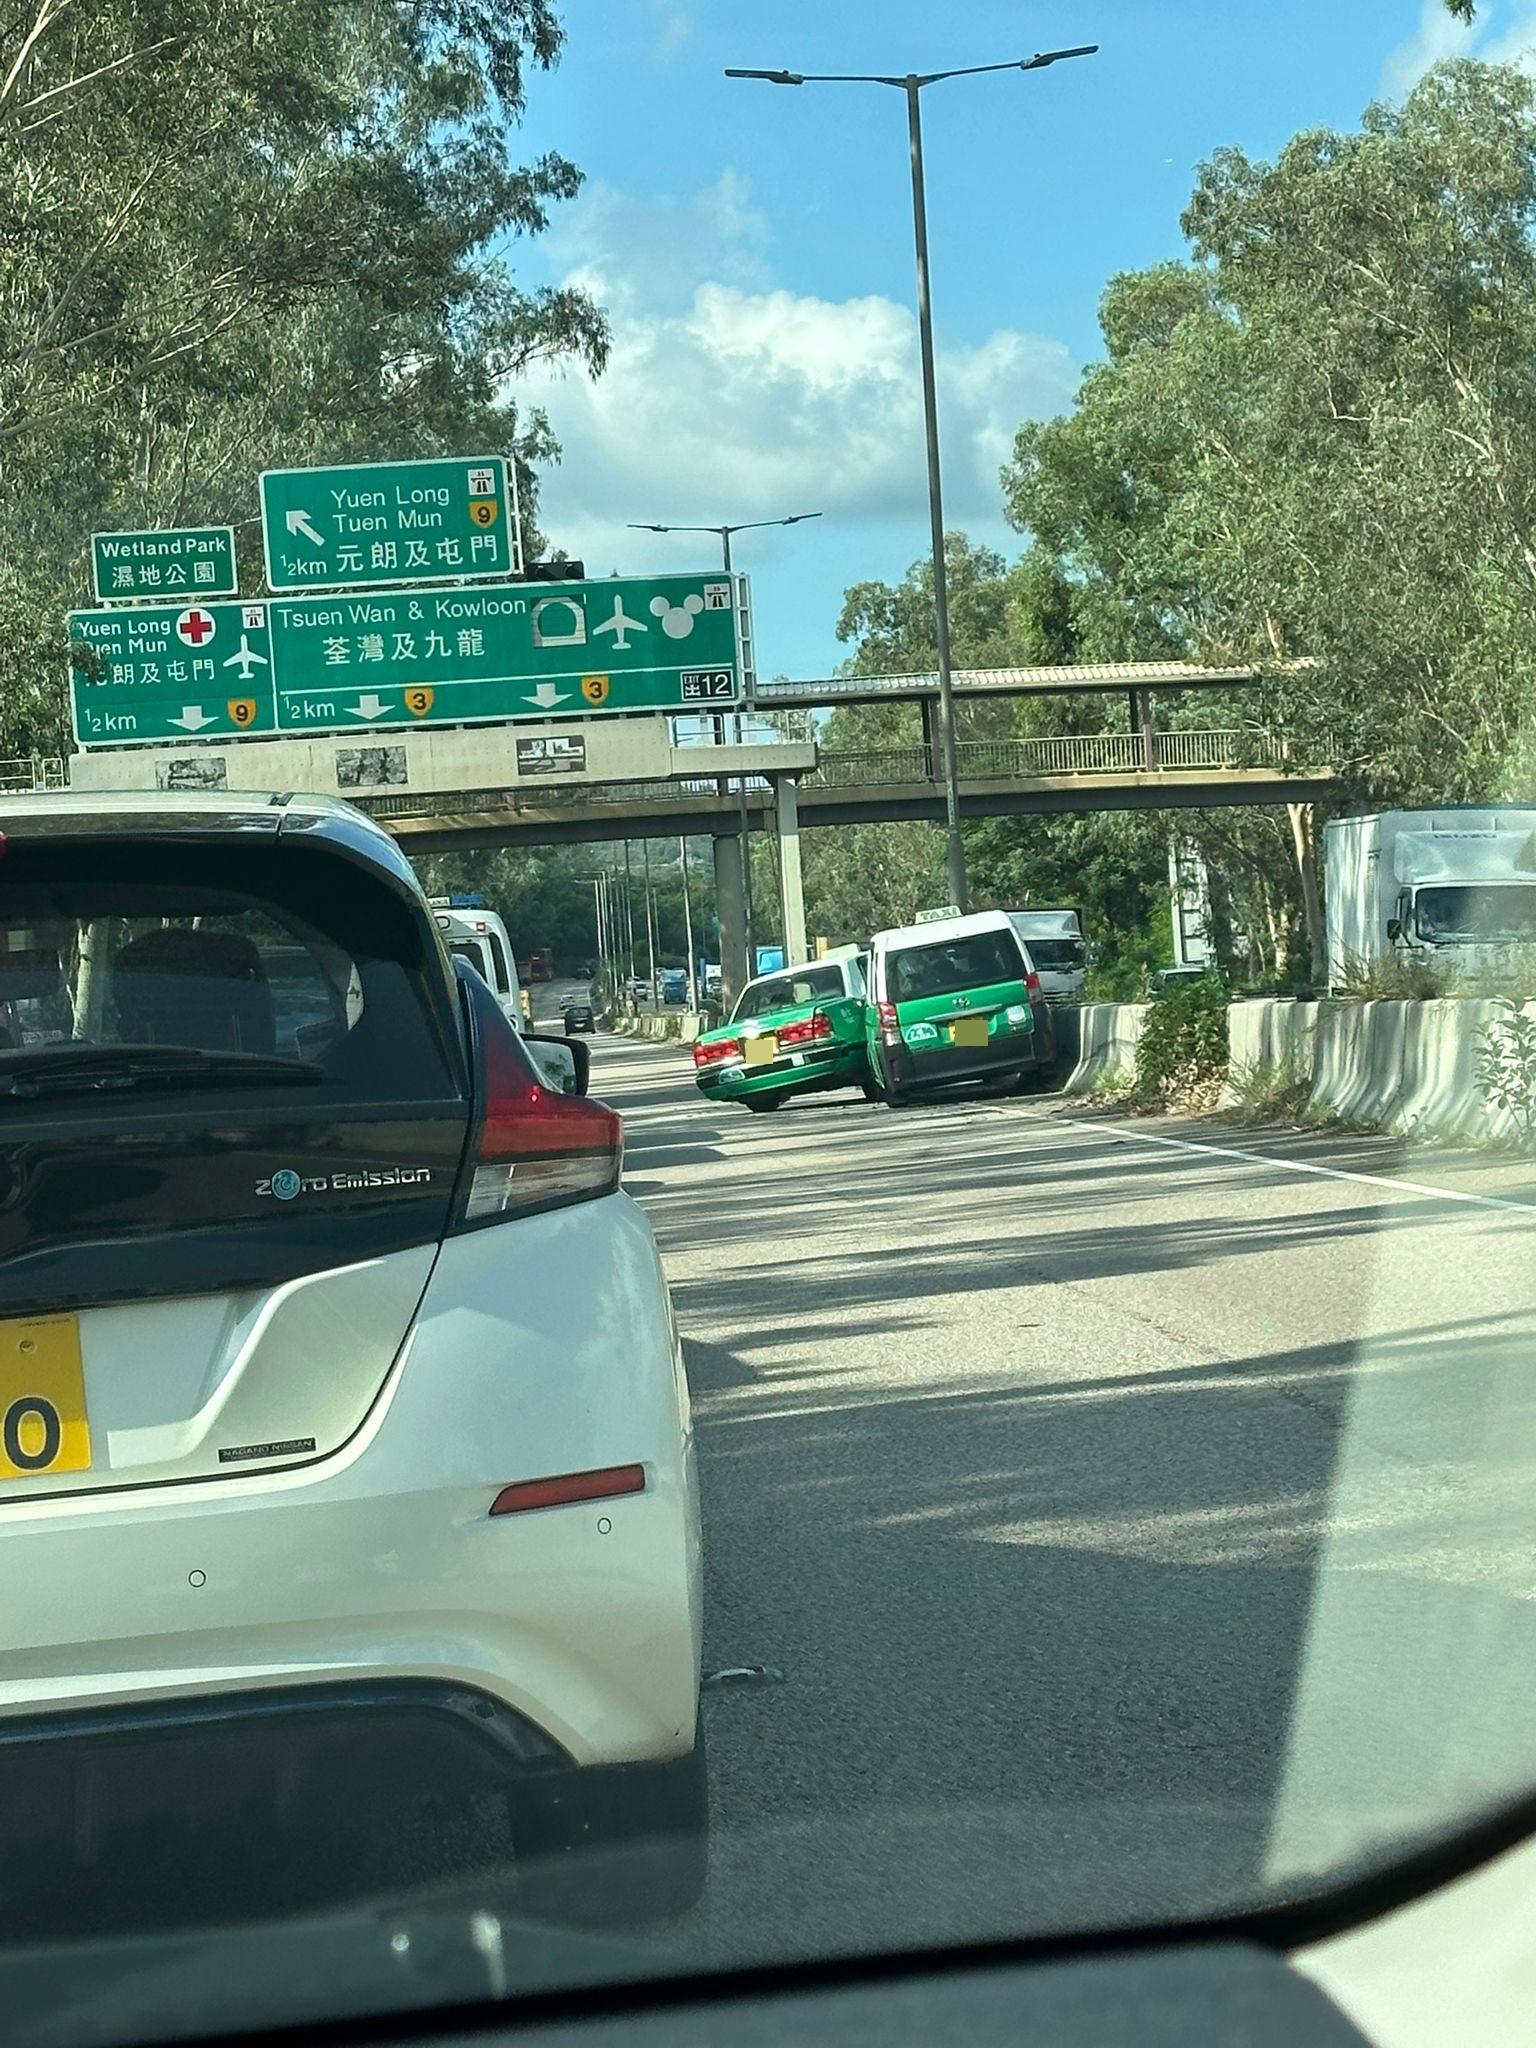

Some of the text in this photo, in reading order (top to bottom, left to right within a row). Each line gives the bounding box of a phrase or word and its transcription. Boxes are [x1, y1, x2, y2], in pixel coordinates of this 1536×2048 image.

[330, 485, 450, 509] Yuen Long
[332, 509, 443, 533] Tuen Mun
[477, 505, 491, 524] 9
[101, 537, 226, 558] Wetland Park
[336, 535, 498, 572] 元朗及屯門
[277, 597, 527, 629] Tsuen Wan & Kowloon
[78, 619, 171, 637] Yuen Long
[128, 637, 167, 654] Mun
[322, 628, 486, 666] 荃灣及九龍
[588, 681, 603, 699] 3
[701, 673, 730, 695] 12
[412, 692, 427, 711] 3
[235, 705, 248, 722] 9
[920, 907, 957, 921] TAXI
[331, 1167, 431, 1189] Emission
